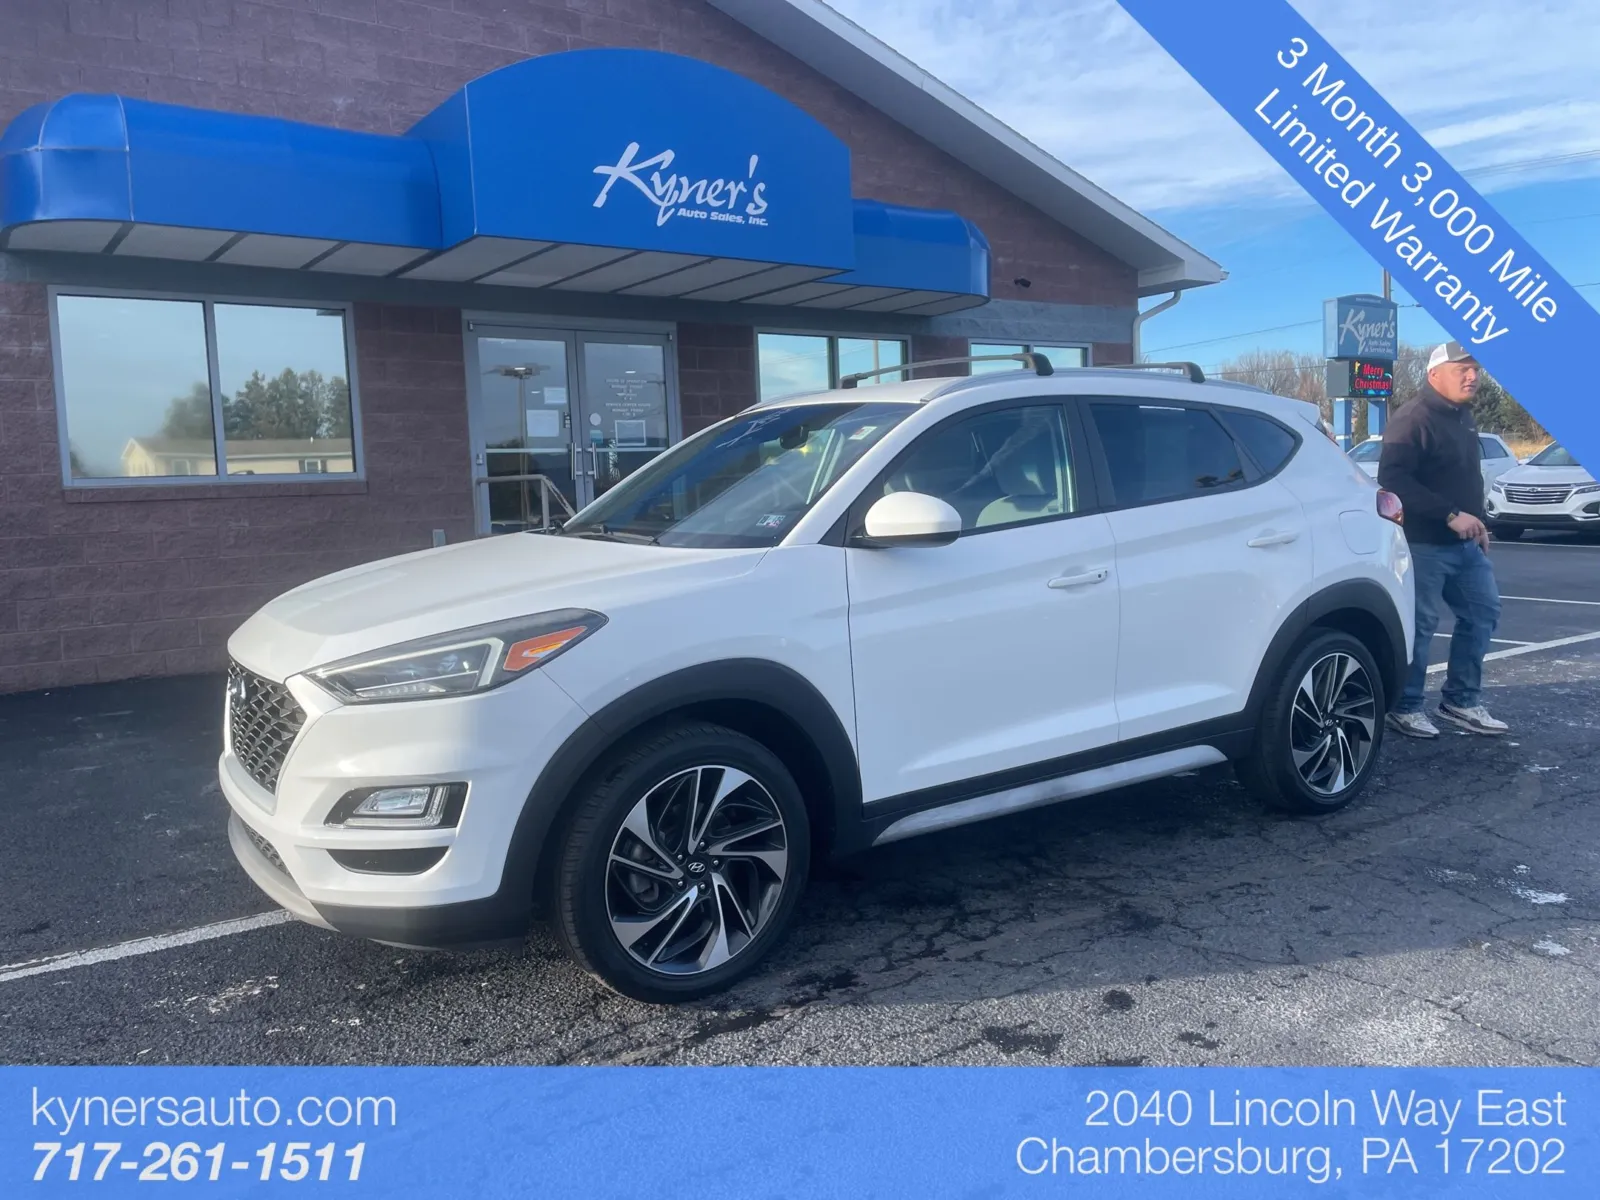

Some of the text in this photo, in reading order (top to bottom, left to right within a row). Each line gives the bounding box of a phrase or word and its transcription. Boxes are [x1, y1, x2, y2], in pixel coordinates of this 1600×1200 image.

[593, 141, 768, 227] Kyner's
[677, 208, 769, 226] Auto Sales, Inc.
[1339, 308, 1395, 355] Kyner's
[1363, 363, 1384, 378] Merry
[1354, 378, 1392, 389] Christmas!
